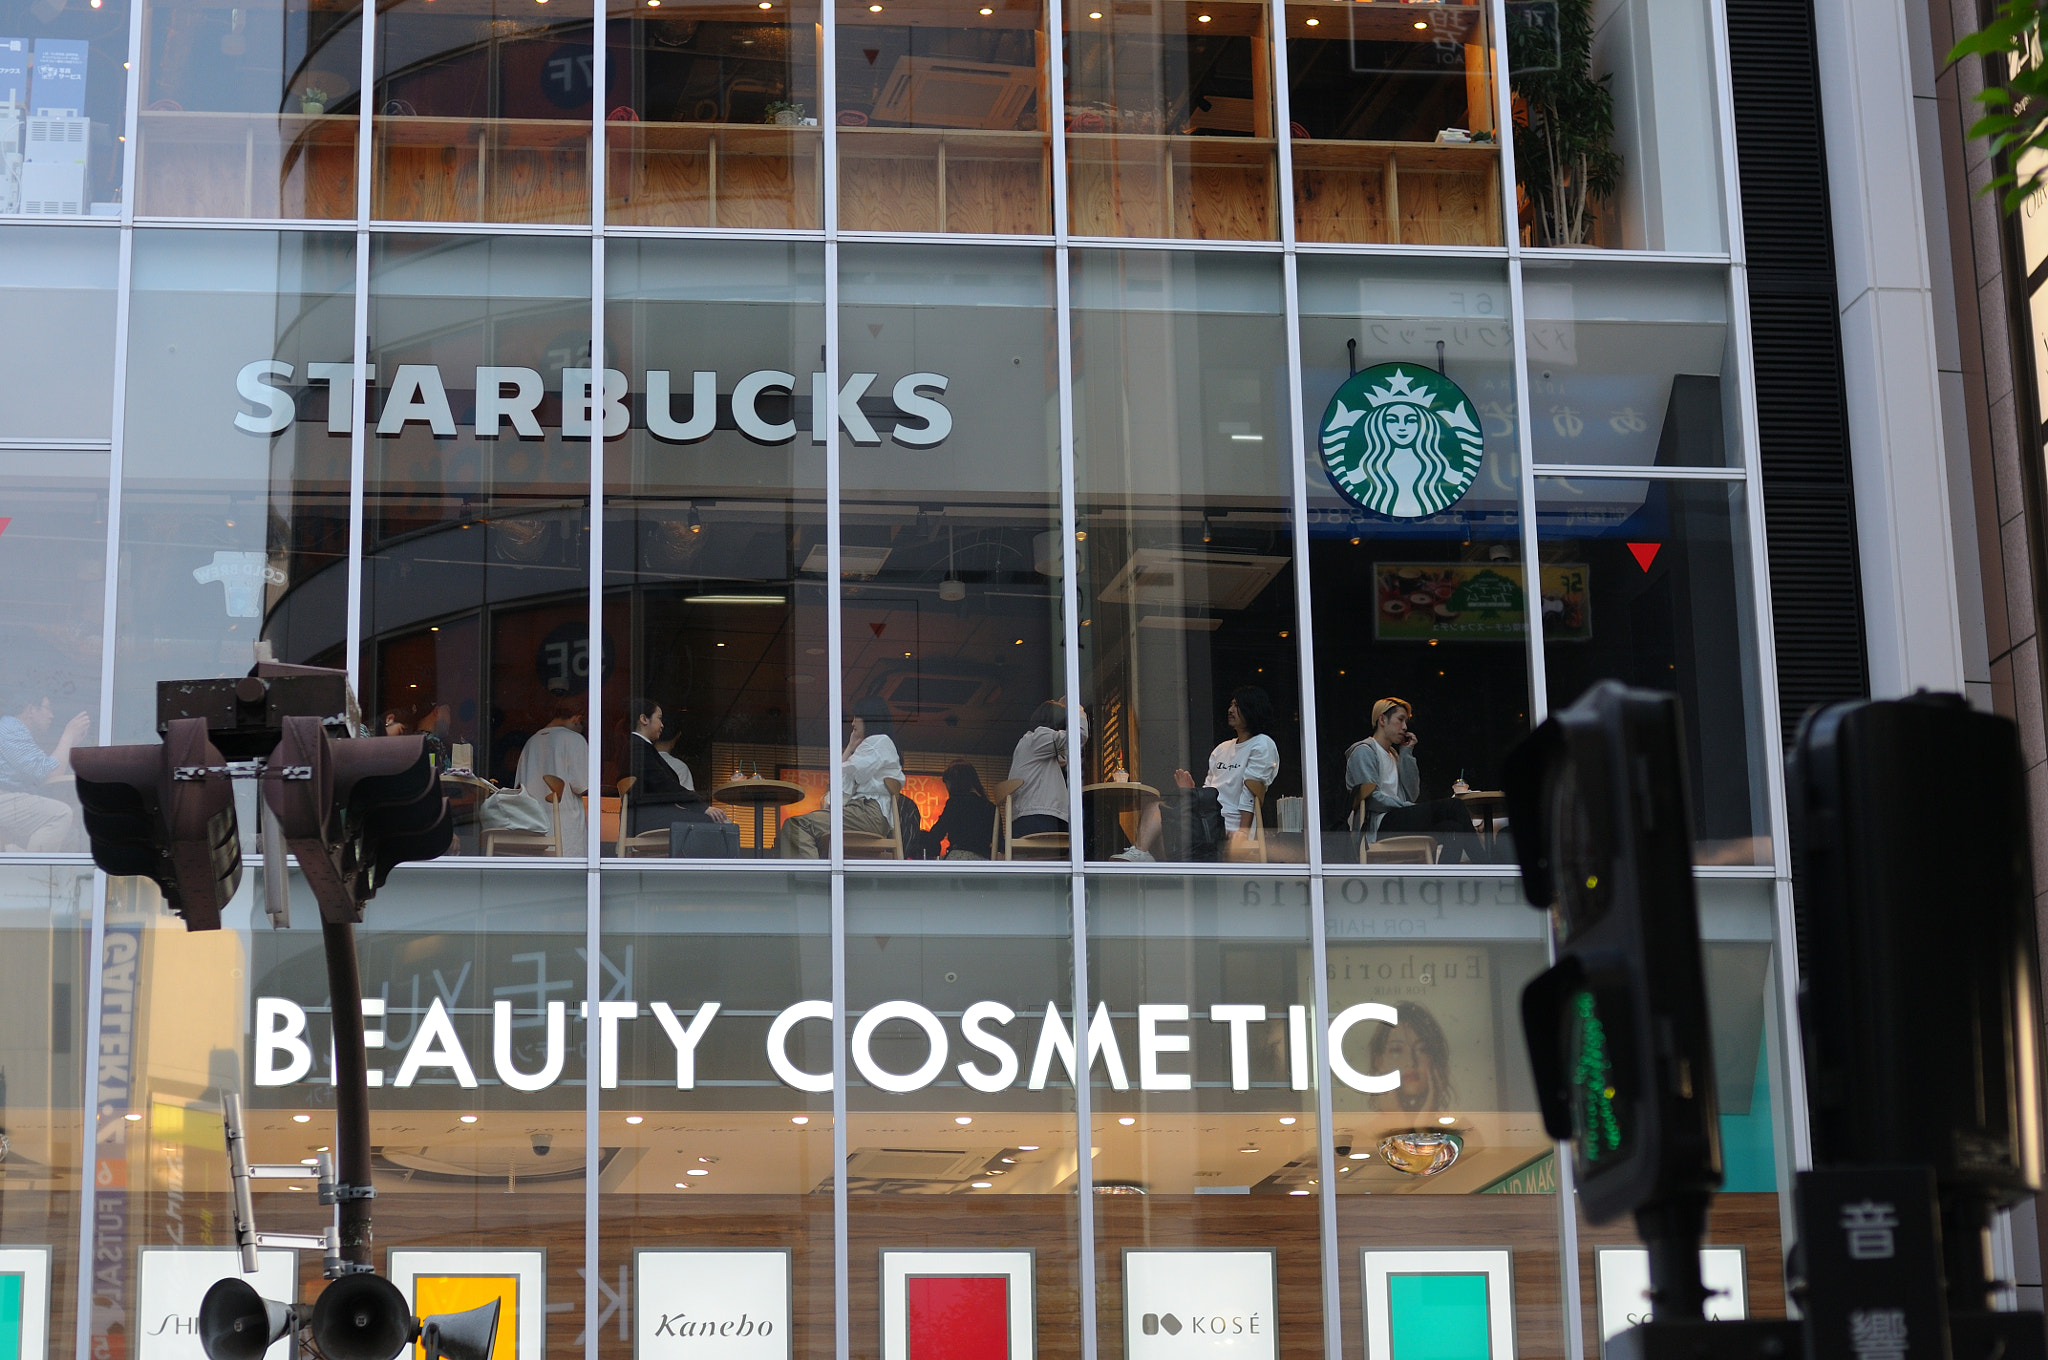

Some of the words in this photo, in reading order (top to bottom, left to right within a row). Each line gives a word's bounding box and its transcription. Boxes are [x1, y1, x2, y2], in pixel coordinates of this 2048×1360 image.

[233, 359, 953, 447] STARBUCKS
[255, 996, 721, 1092] BEAUTY
[766, 999, 1402, 1094] COSMETIC
[655, 1313, 774, 1338] Kanebo
[1192, 1311, 1260, 1335] KOSÉ
